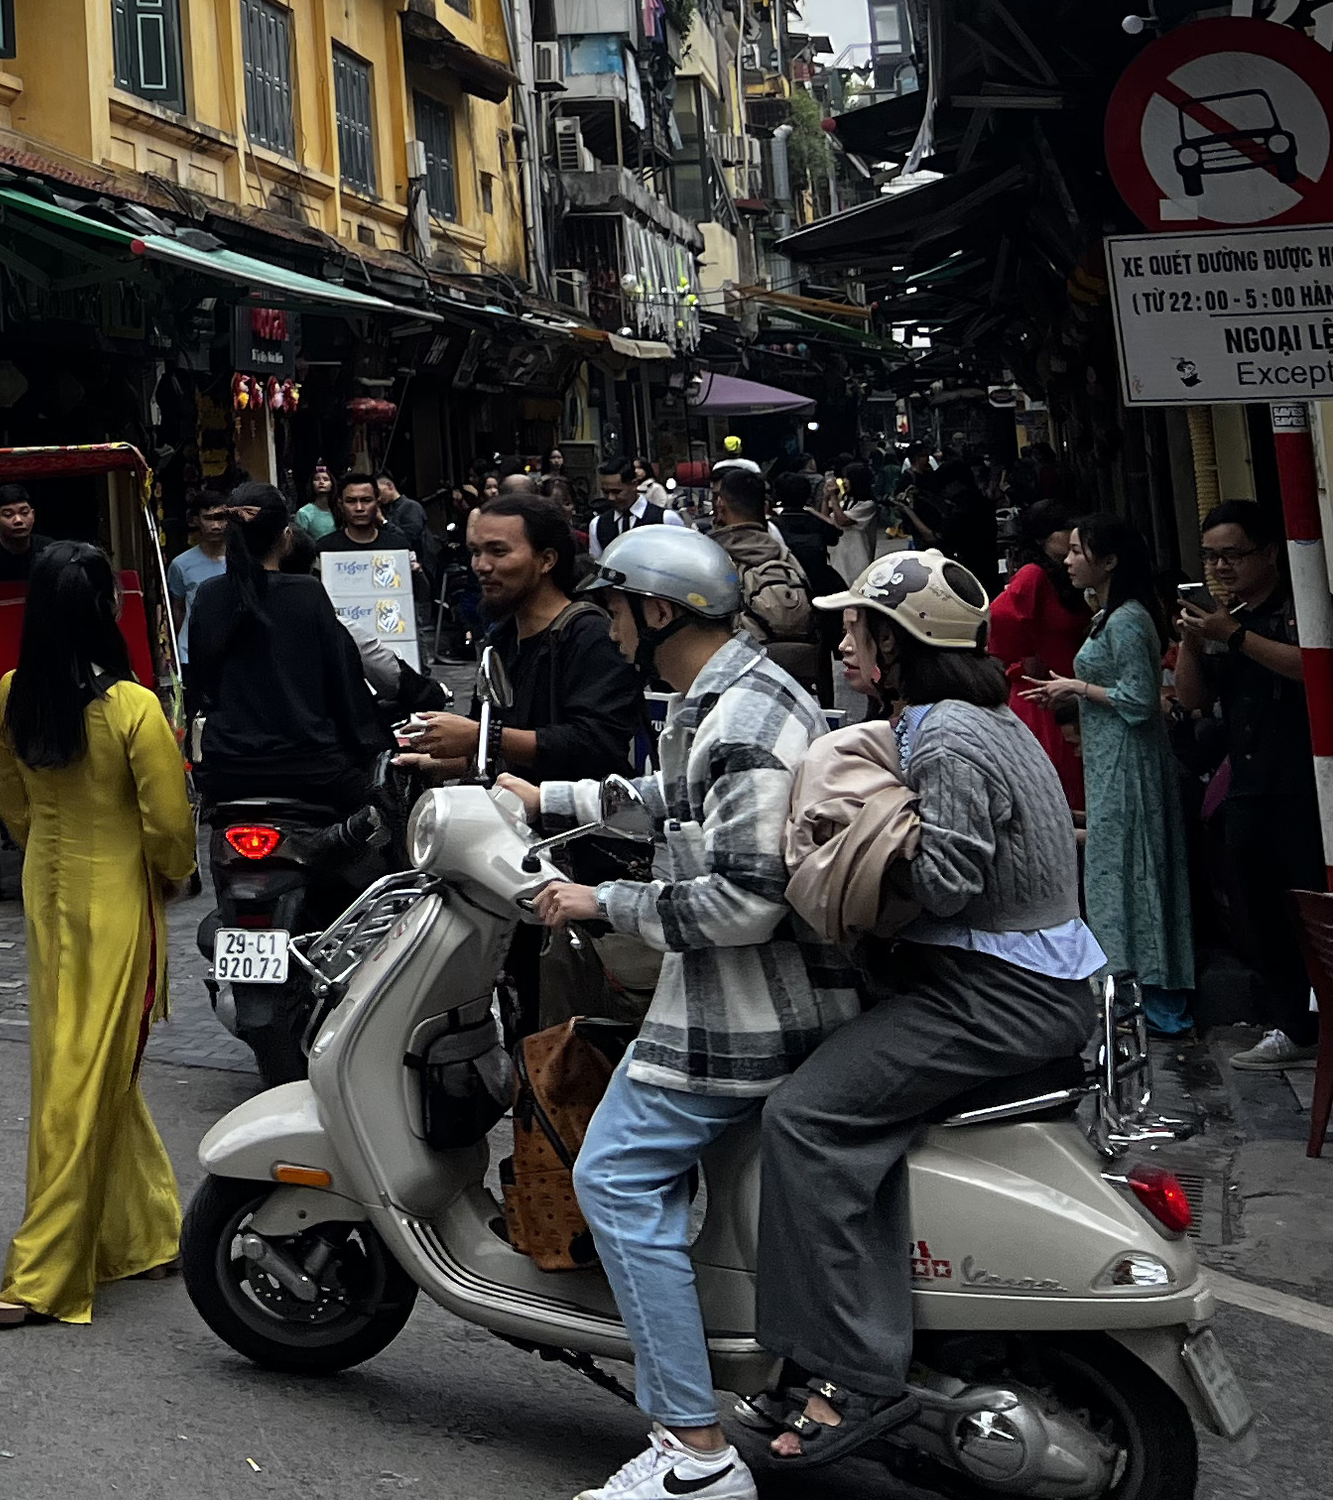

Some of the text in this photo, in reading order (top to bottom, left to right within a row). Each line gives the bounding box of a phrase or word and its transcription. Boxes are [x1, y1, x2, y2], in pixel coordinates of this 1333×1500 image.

[1121, 246, 1333, 278] XE QUÉT ĐƯỜNG ĐƯỢC H
[1224, 323, 1302, 356] NGOẠI
[1237, 358, 1333, 389] Except
[335, 561, 369, 575] Tiger
[339, 605, 373, 620] Tiger
[225, 933, 277, 955] 29-C1
[218, 957, 283, 980] 920.72
